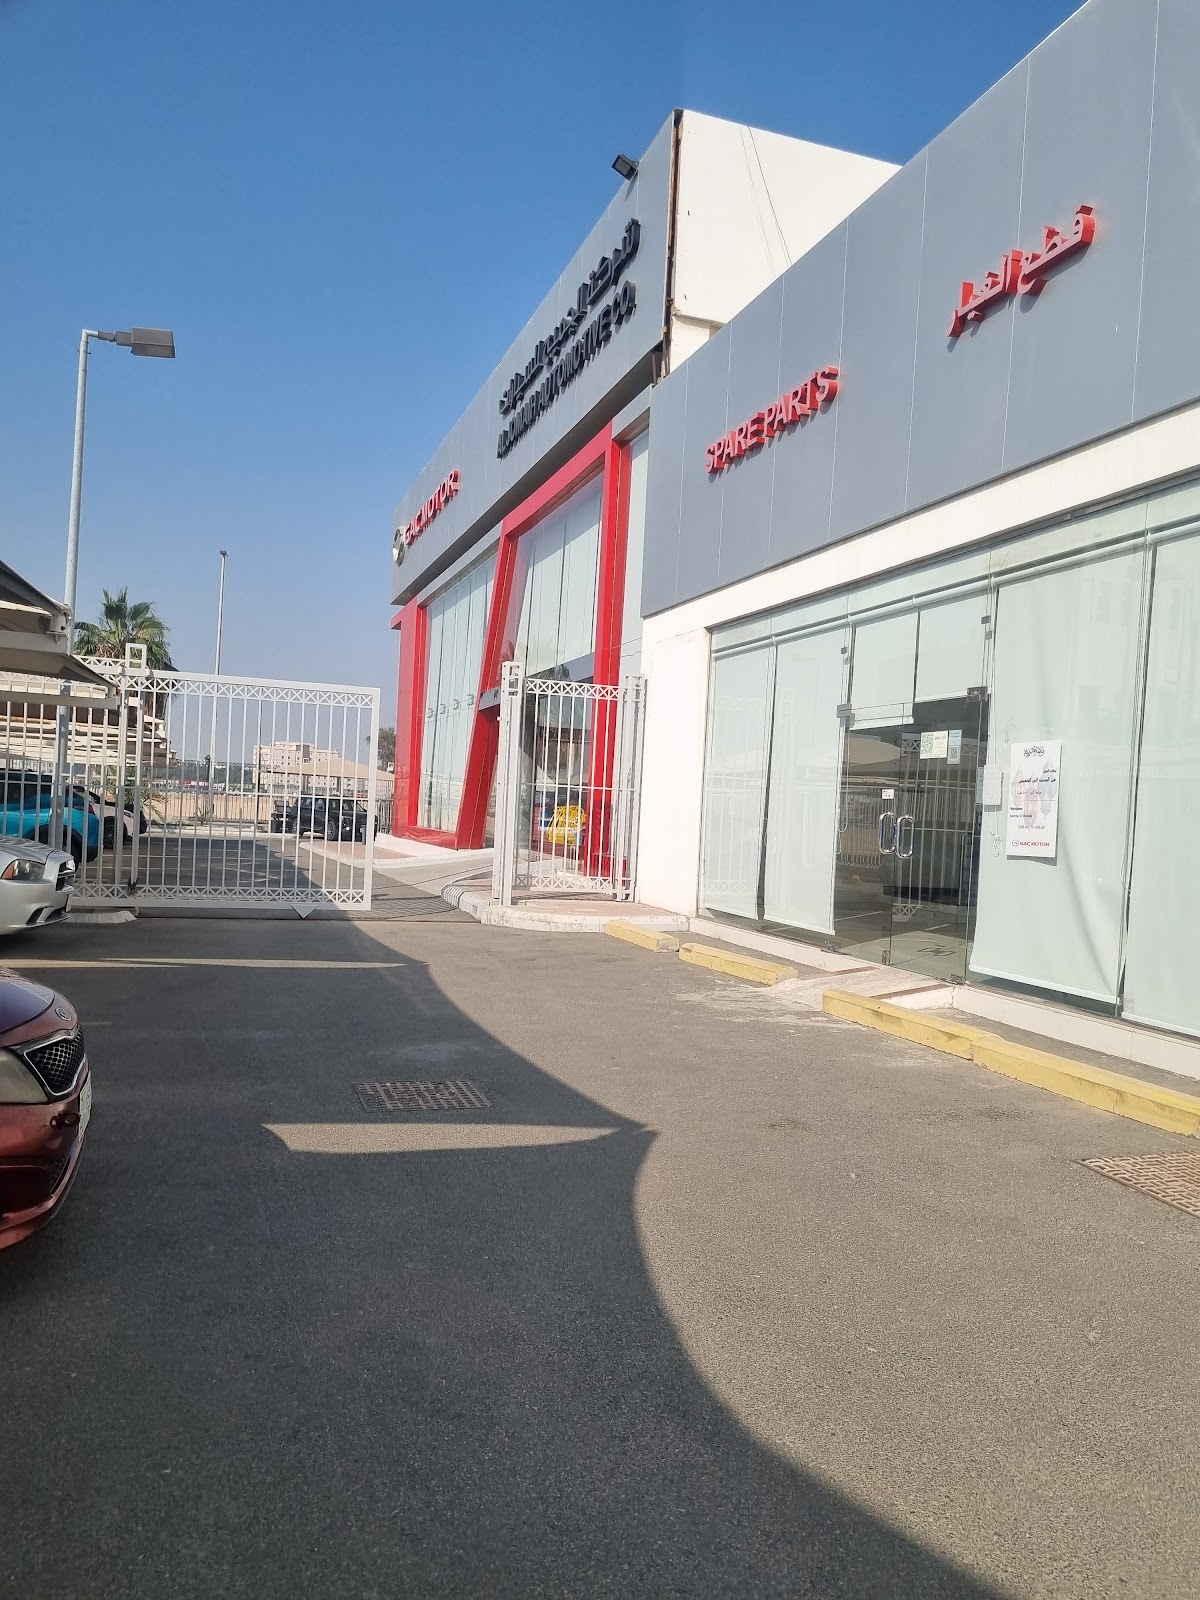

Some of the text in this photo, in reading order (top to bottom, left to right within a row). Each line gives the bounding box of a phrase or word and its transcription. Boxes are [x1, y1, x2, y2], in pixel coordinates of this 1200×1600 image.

[586, 218, 641, 305] شركة
[946, 204, 1096, 338] قطع الغيار
[537, 304, 613, 412] AUTOMOTIVE
[543, 282, 589, 367] الجميح
[705, 365, 840, 474] SPARE PARTS
[405, 468, 460, 546] GAC MOTOR
